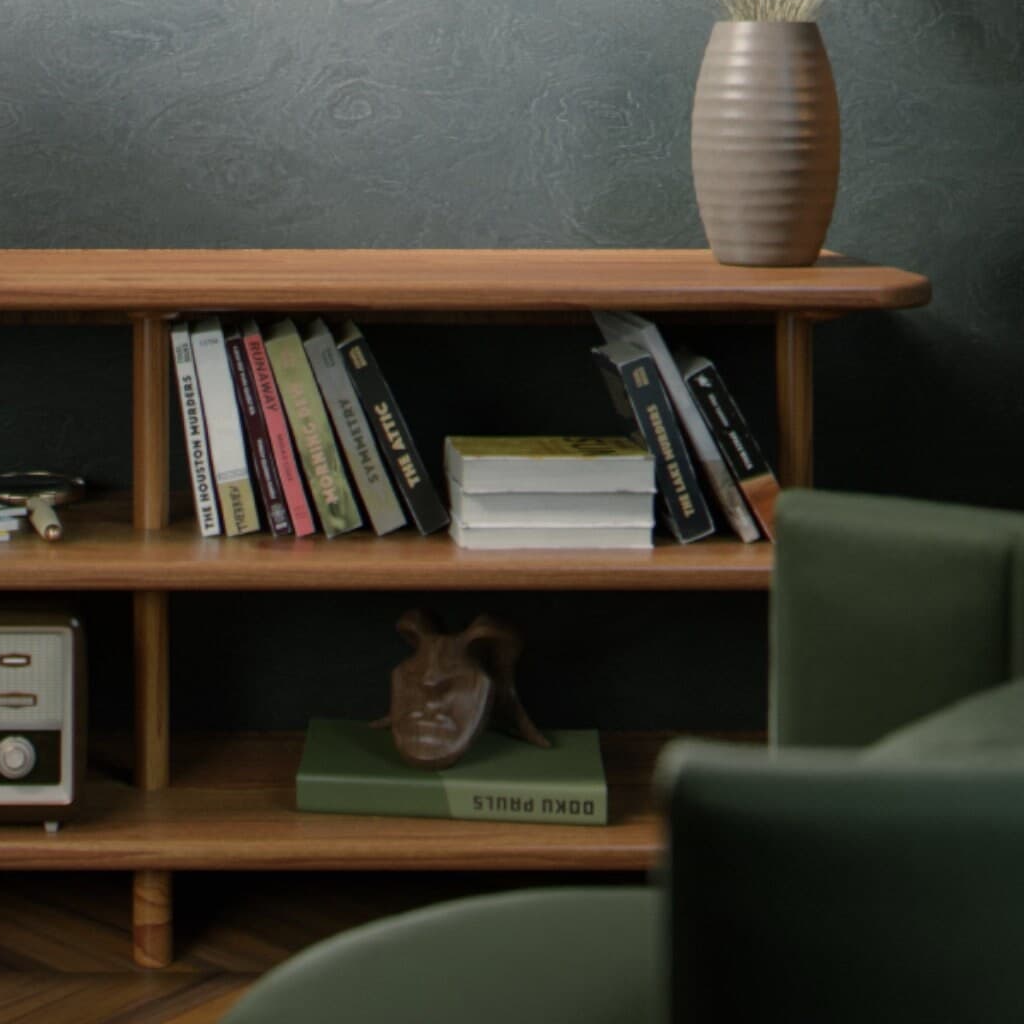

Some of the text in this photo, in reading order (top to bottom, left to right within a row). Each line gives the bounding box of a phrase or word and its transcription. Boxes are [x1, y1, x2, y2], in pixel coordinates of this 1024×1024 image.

[182, 375, 199, 434] MURDERS
[249, 341, 278, 411] RUNAWAY
[191, 440, 209, 503] HOUSTON
[301, 422, 338, 504] MORNING
[339, 399, 377, 483] SYMMETRY
[374, 401, 421, 488] THE ATTIC
[203, 506, 214, 529] THE
[679, 493, 695, 517] THE
[473, 796, 533, 812] PAULS
